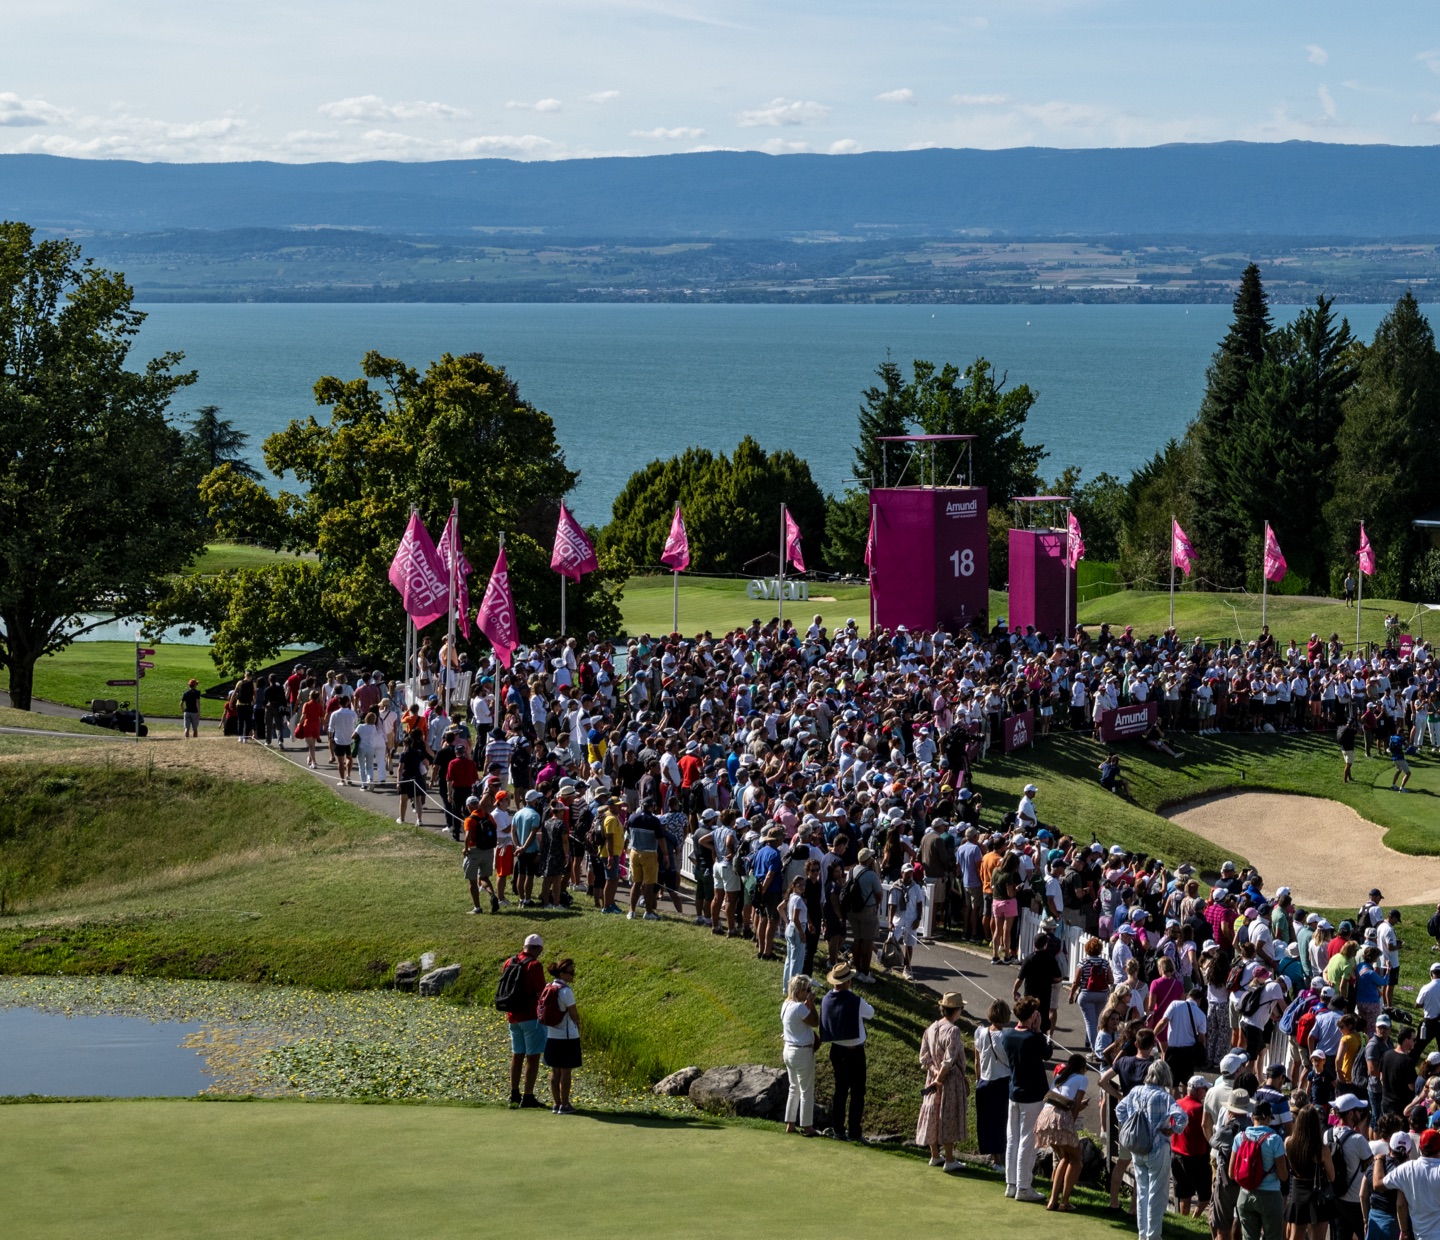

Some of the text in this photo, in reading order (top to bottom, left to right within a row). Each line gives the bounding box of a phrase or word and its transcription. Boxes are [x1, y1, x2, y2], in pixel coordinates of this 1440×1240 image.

[946, 499, 978, 512] Amundi
[554, 536, 581, 567] vian
[558, 518, 592, 559] Amundi
[410, 540, 450, 598] Amundi
[949, 548, 975, 578] 18
[485, 582, 511, 635] evia
[481, 603, 510, 648] MPIONSHIP
[1115, 708, 1148, 726] Amundi
[1012, 730, 1028, 747] evian
